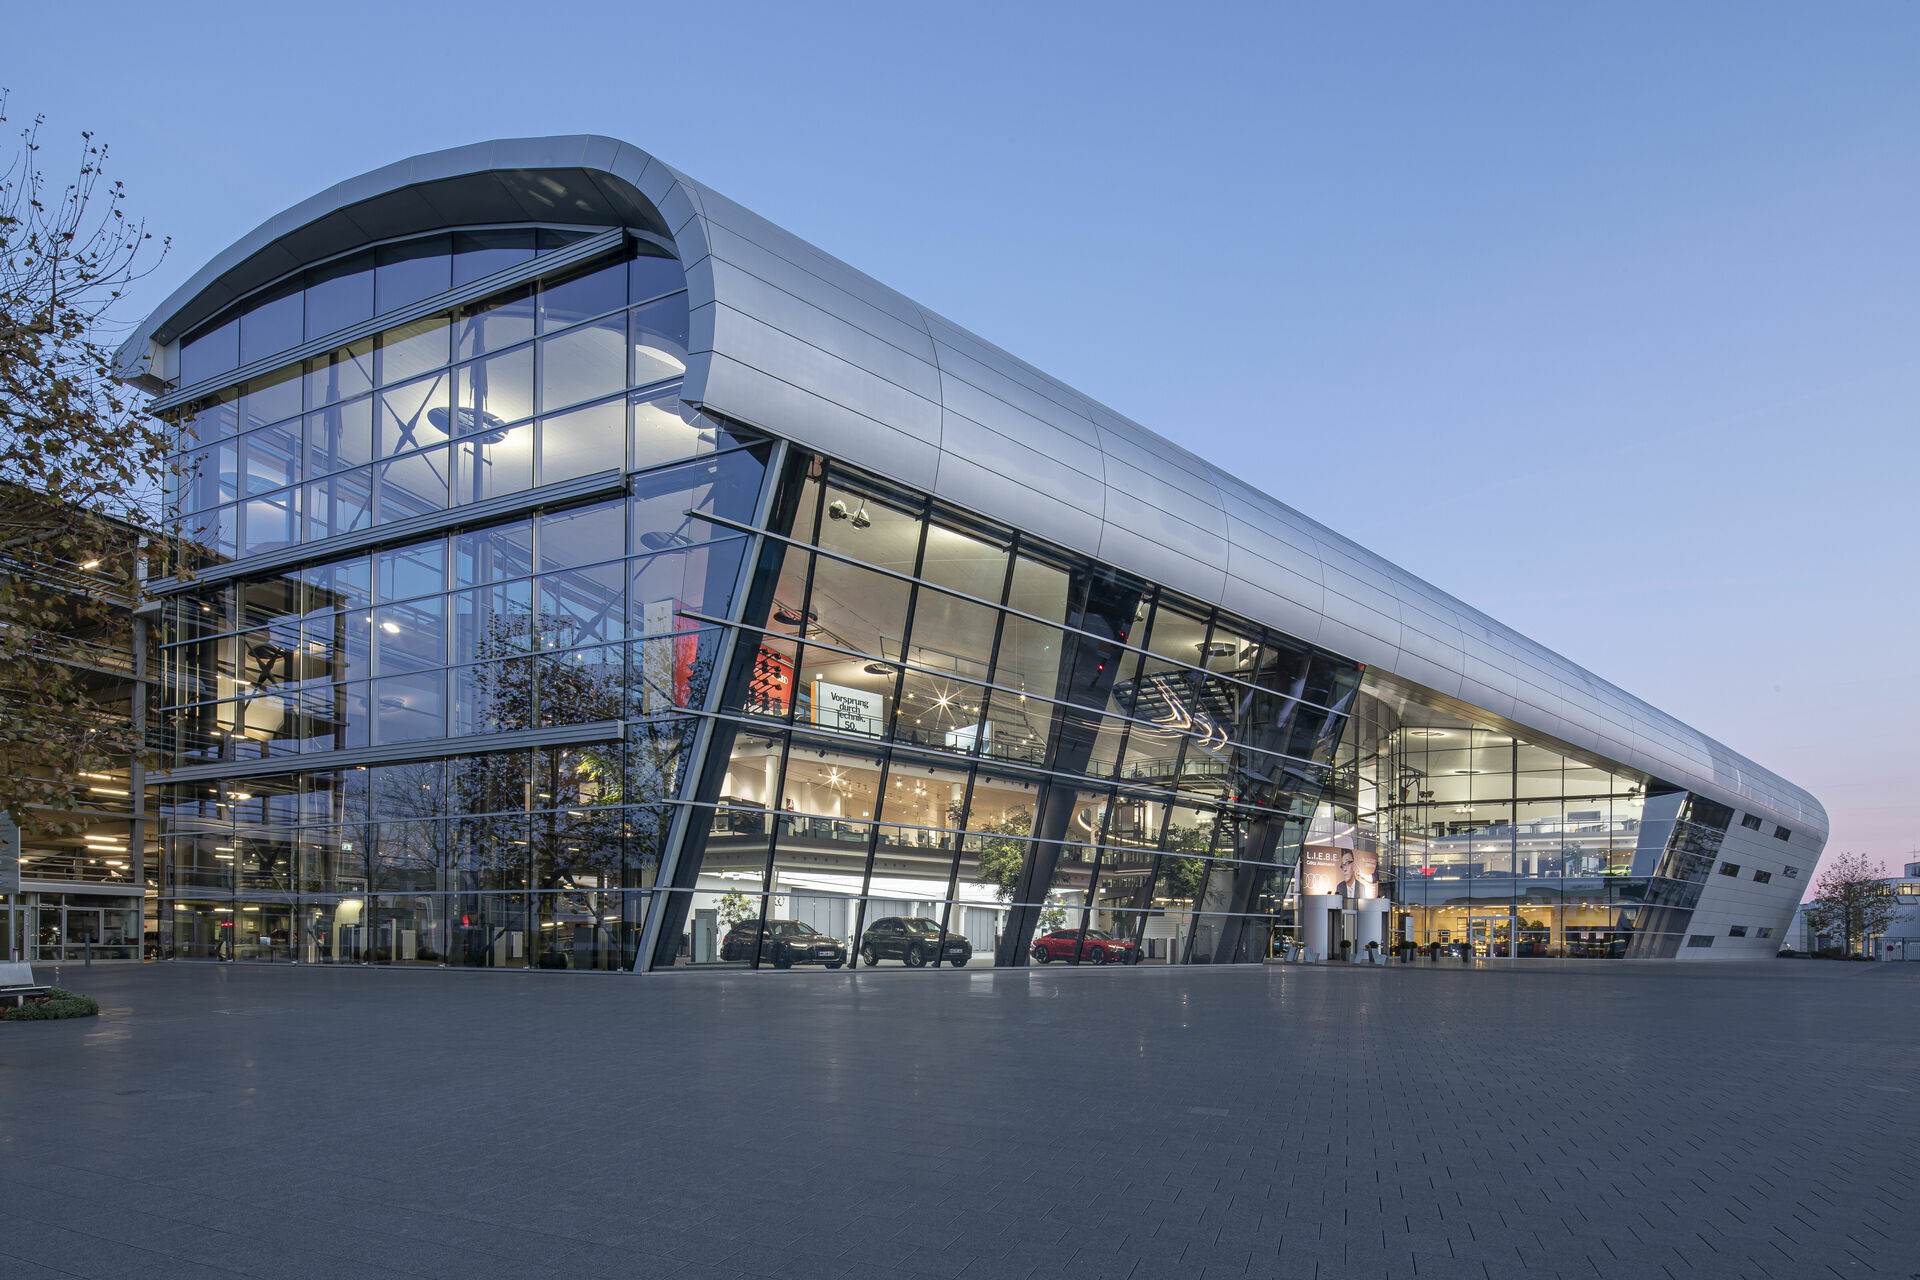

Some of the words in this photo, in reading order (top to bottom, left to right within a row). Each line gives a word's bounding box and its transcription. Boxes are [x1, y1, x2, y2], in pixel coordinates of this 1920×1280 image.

[831, 692, 869, 708] Vorsprung
[839, 703, 860, 713] durch
[837, 711, 865, 722] echnik.
